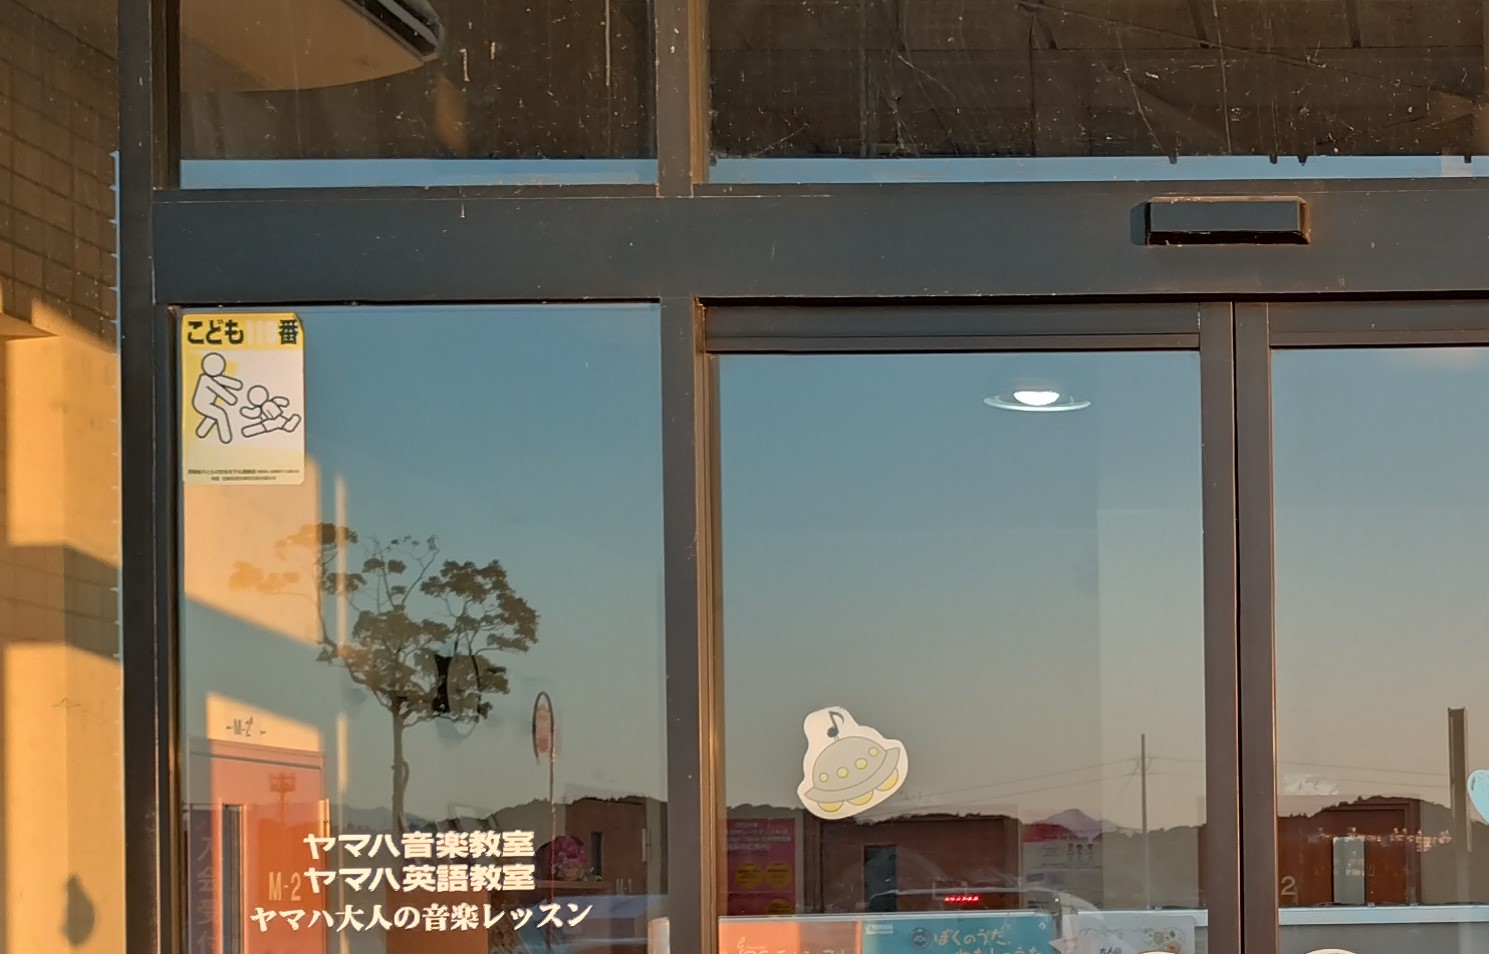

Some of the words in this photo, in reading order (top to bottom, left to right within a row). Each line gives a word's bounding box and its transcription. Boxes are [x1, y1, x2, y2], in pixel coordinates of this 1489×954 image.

[302, 830, 536, 860] ヤマハ音楽教室
[268, 871, 301, 901] M-2
[302, 864, 536, 894] ヤマハ英語教室
[249, 903, 595, 933] ヤマハ大人の音楽レッスン
